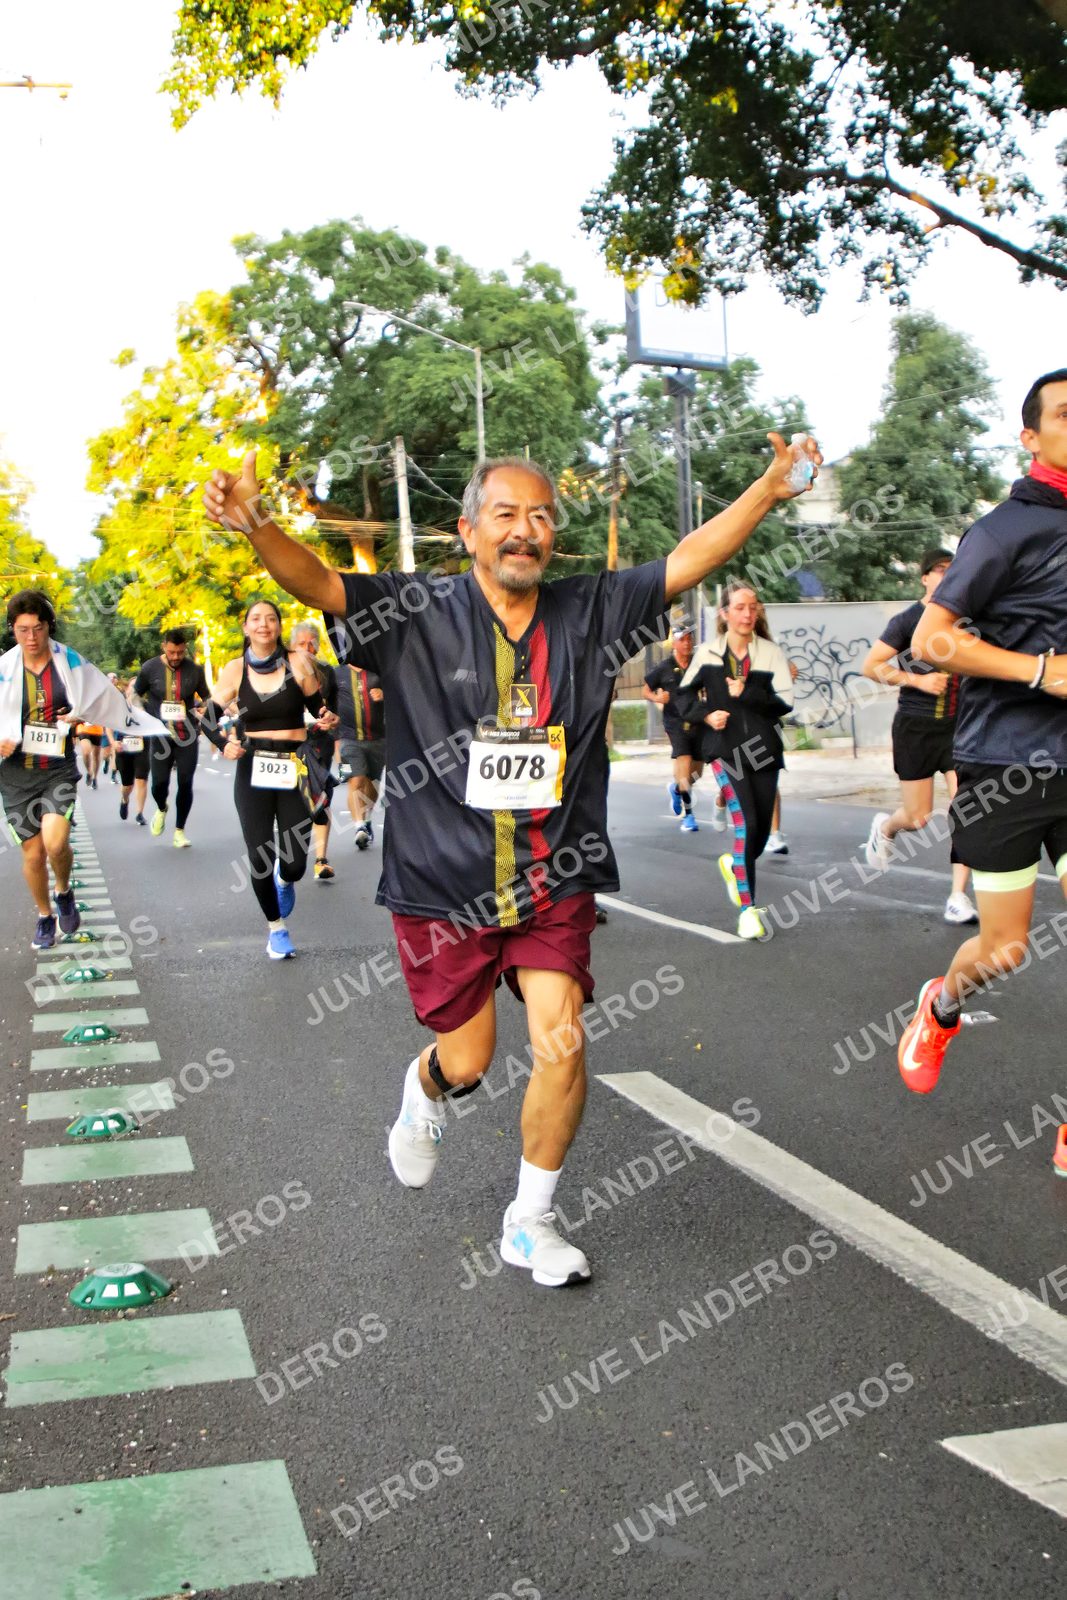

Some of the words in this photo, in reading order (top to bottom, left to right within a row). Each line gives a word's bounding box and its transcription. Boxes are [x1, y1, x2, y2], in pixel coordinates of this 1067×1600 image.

[780, 624, 826, 640] TOY
[31, 731, 57, 744] 1811
[259, 762, 288, 774] 3023
[479, 754, 546, 780] 6078
